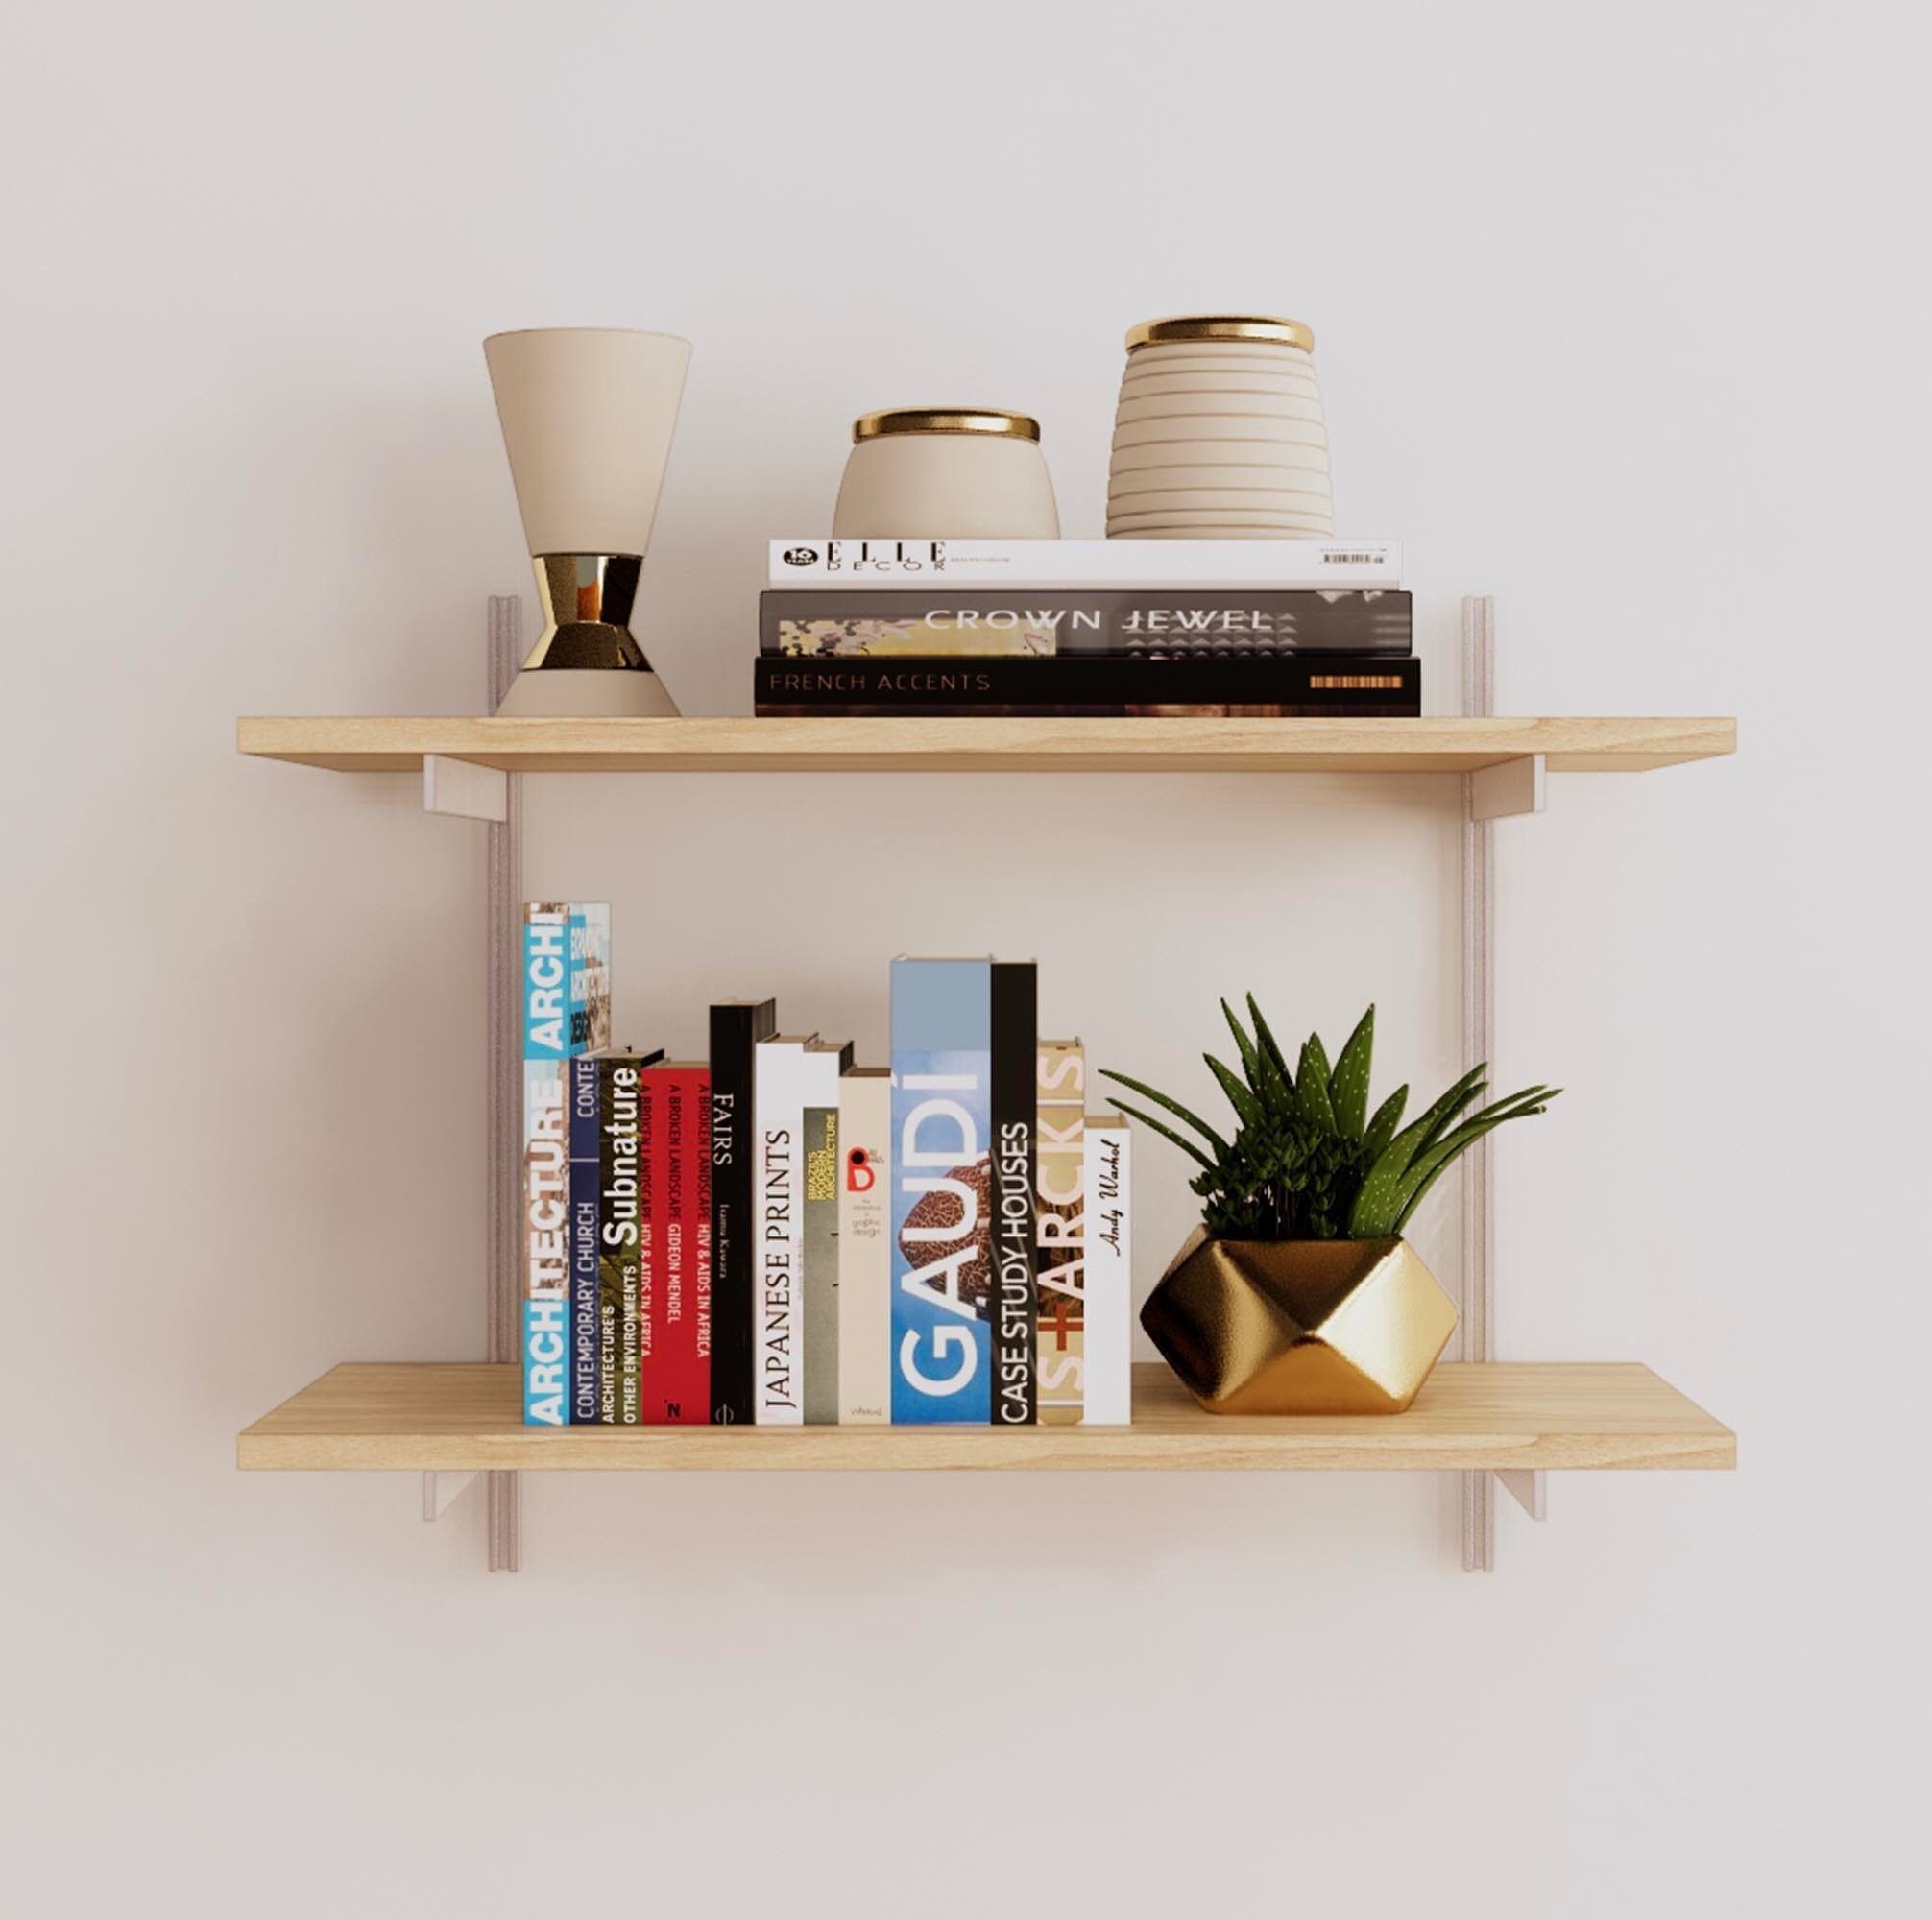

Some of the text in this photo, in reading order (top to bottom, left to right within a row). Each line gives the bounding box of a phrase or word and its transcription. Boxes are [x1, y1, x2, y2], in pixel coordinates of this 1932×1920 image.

[827, 541, 946, 562] ELLE
[827, 562, 946, 570] DECOR
[924, 610, 1274, 632] CROWN JEWEL
[769, 673, 990, 690] FRENCH ACCENTS
[603, 1068, 638, 1246] Subnature
[712, 1093, 734, 1165] FAIRS
[808, 1151, 817, 1200] BRAZIL'S
[816, 1150, 827, 1200] MODERN
[826, 1114, 836, 1200] ARCHITECTURE
[529, 1080, 564, 1425] ARCHITECTURE
[667, 1084, 681, 1324] A BROKEN LANDSCAPE GIDEON MENDEL
[697, 1084, 710, 1358] A BROKEN LANDSCAPE HIV & AIDS IN AFRICA
[891, 1068, 979, 1397] GAUDÍ
[1098, 1138, 1123, 1258] Andy Warhol
[576, 1202, 595, 1419] CONTEMPORARY CHURCH
[764, 1129, 796, 1409] JAPANESE PRINTS
[1001, 1122, 1029, 1423] CASE STUDY HOUSES
[602, 1306, 616, 1424] ARCHITECTURE'S
[622, 1264, 637, 1424] OTHER ENVIRONMENTS
